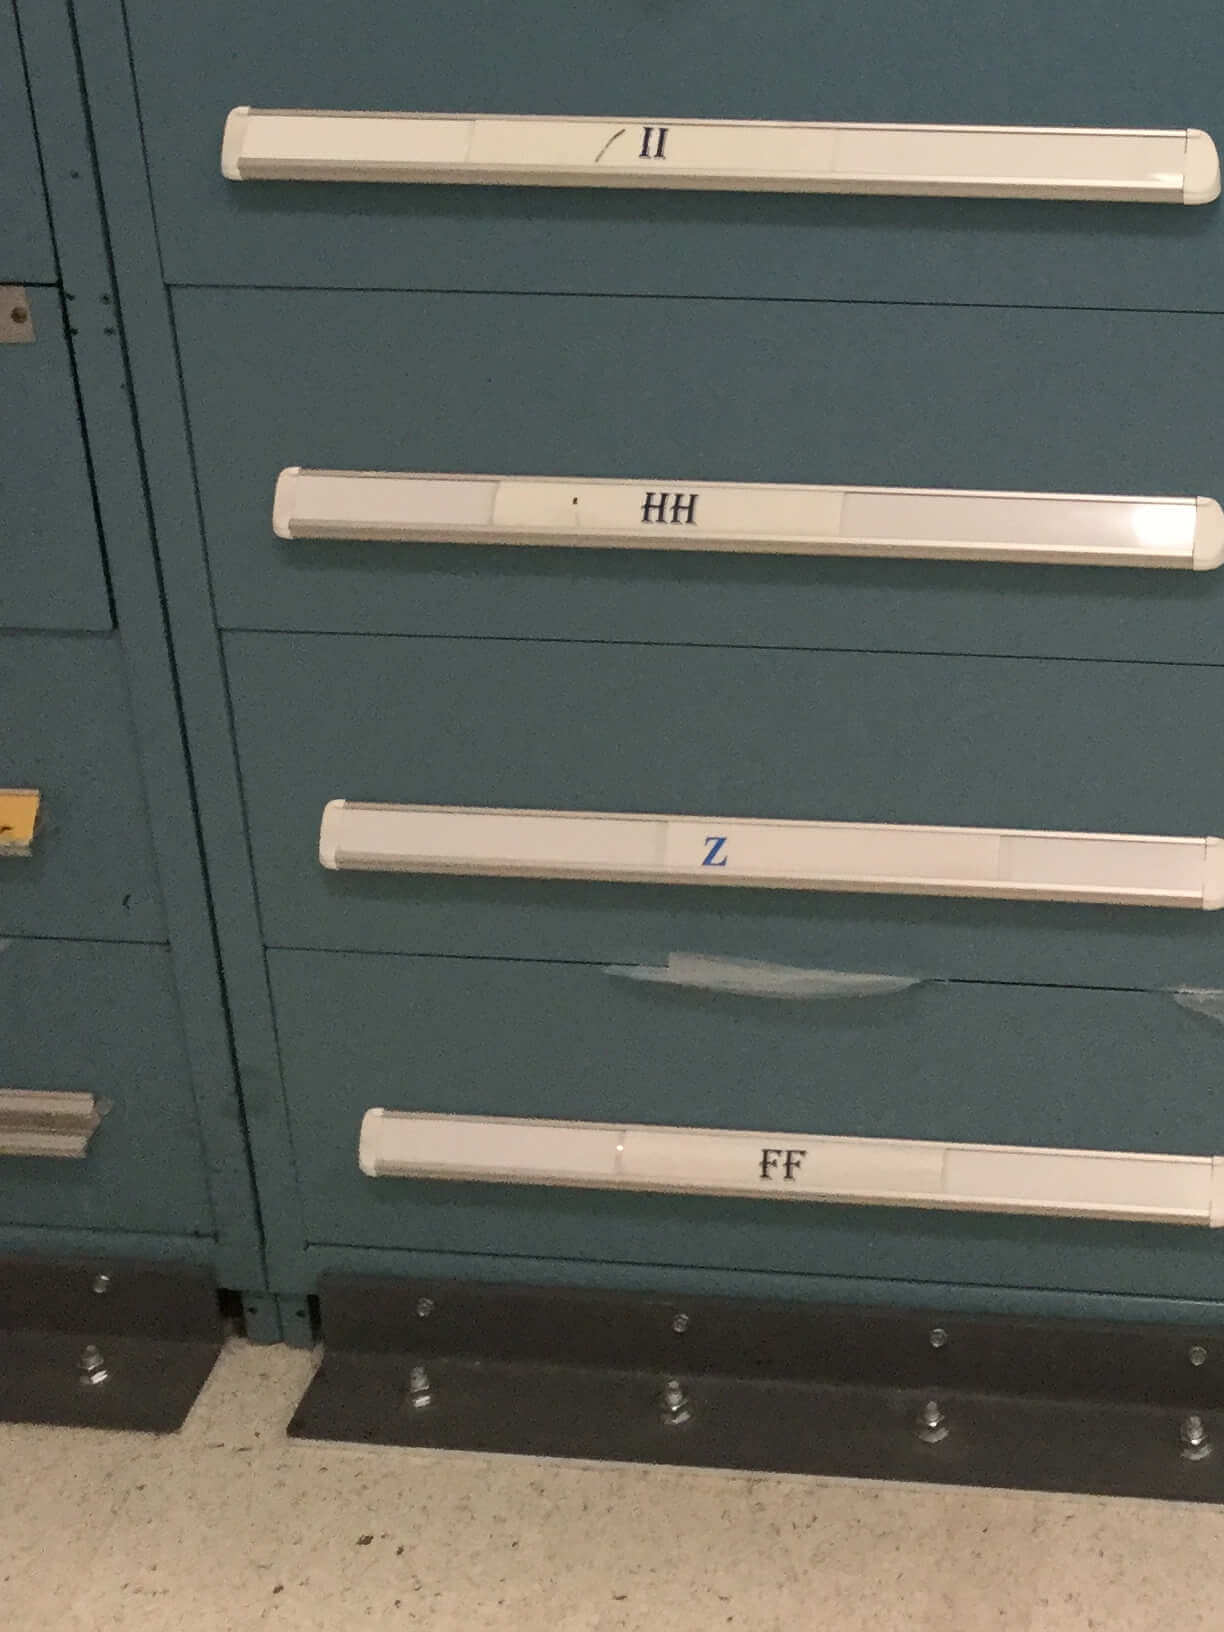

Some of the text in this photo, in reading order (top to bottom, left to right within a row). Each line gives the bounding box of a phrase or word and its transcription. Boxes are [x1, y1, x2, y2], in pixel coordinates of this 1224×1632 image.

[639, 126, 669, 160] II
[641, 491, 699, 525] HH
[701, 836, 728, 866] Z
[759, 1148, 807, 1180] FF
